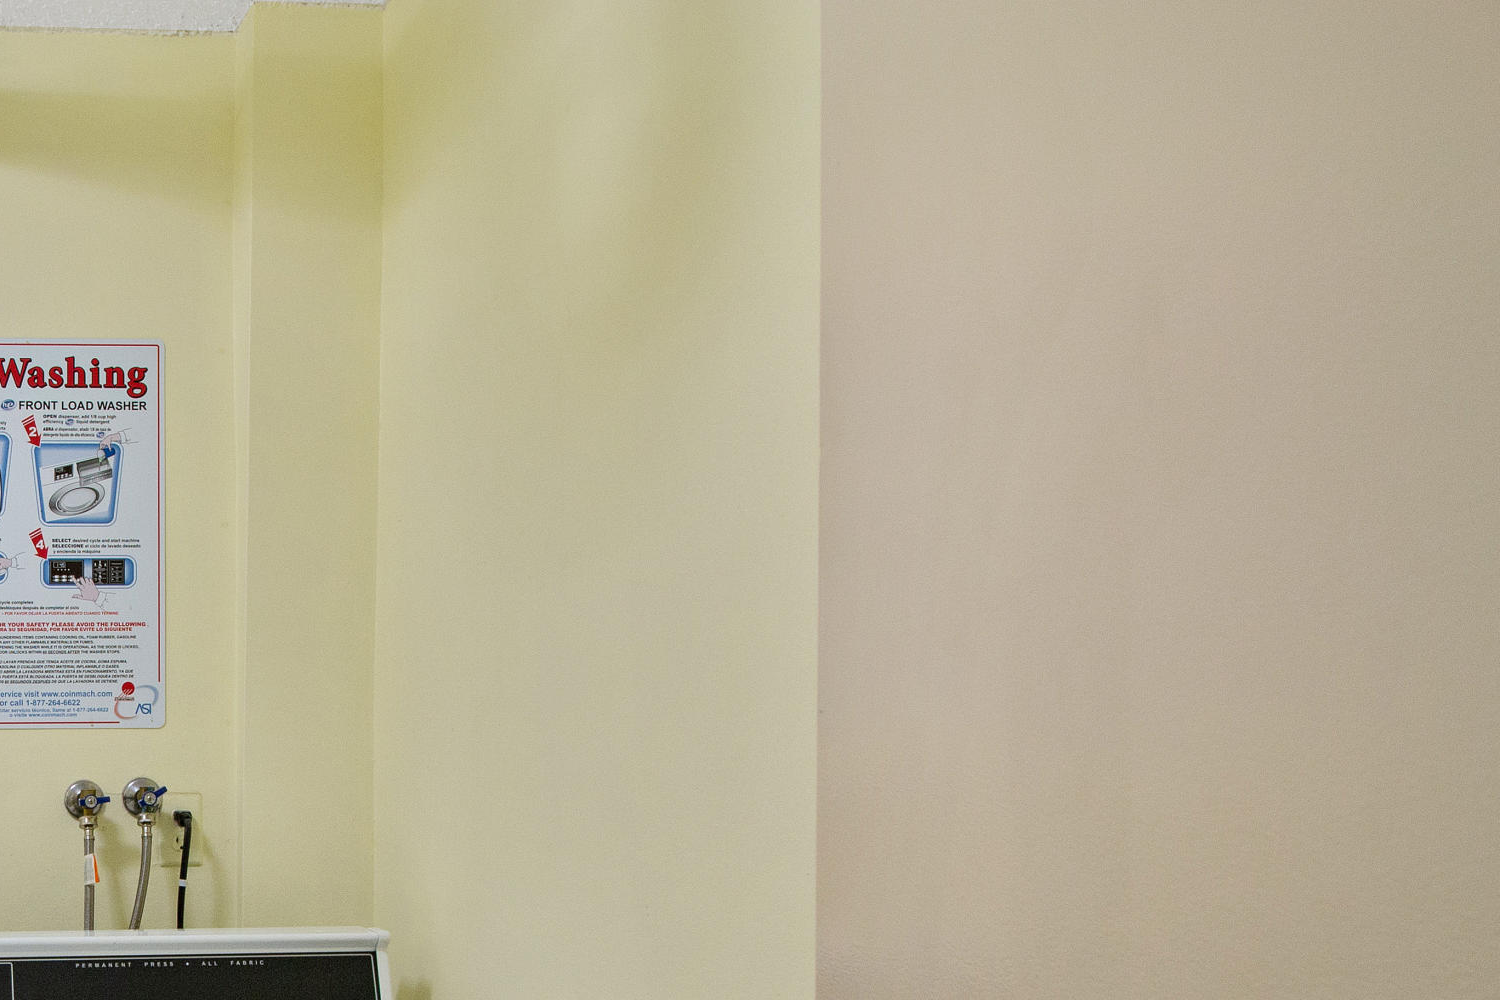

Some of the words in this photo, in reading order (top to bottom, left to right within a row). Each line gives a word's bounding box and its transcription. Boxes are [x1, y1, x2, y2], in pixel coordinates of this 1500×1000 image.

[19, 401, 58, 410] FRONT
[61, 401, 93, 410] LOAD
[97, 402, 146, 410] WASHER
[28, 427, 36, 436] 2
[36, 540, 45, 550] 4
